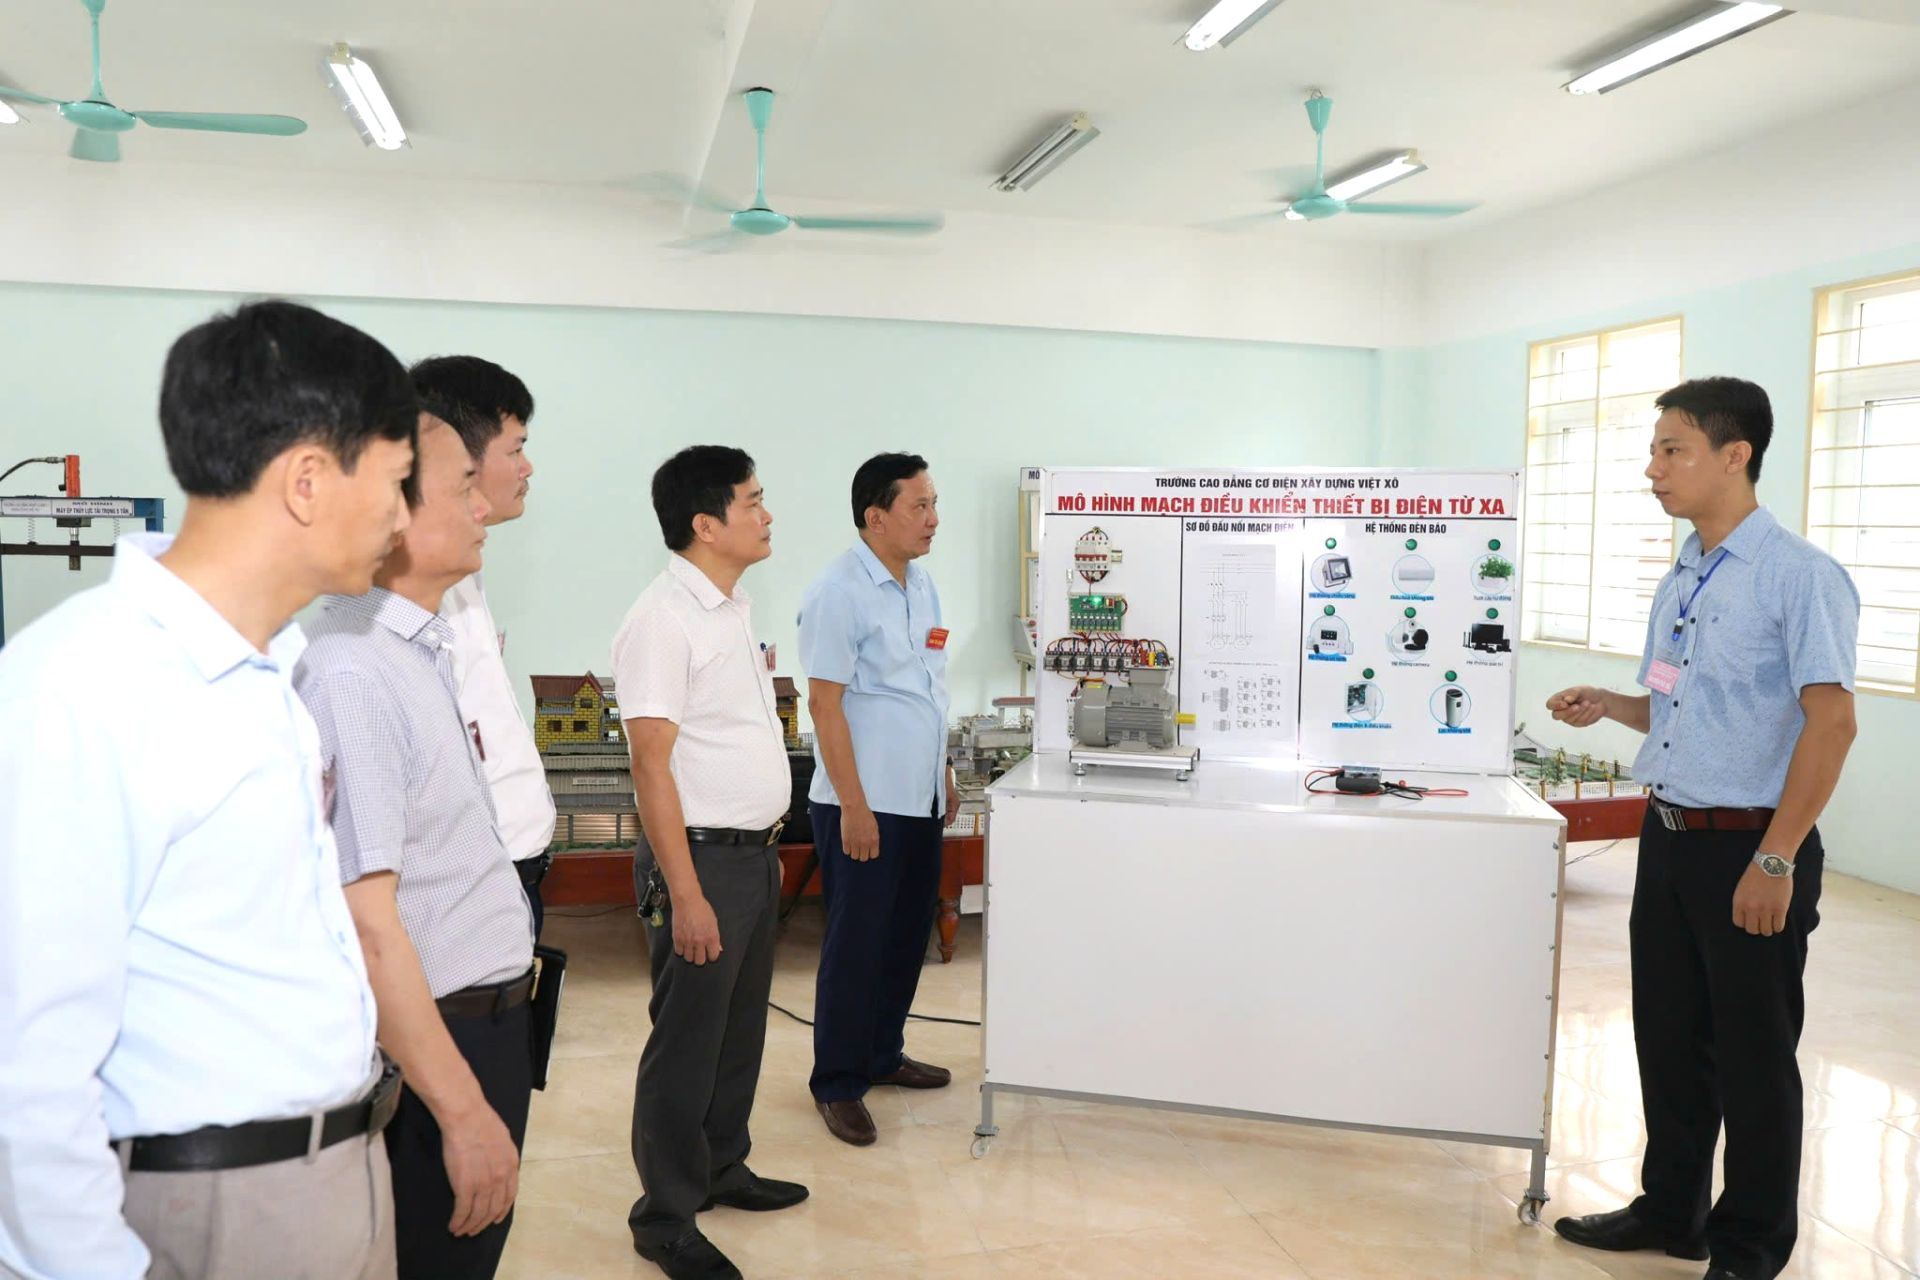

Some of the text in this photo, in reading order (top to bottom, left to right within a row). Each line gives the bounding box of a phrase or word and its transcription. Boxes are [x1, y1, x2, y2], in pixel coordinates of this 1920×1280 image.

[1155, 474, 1399, 490] TRƯỜNG CAO ĐẲNG CƠ ĐIỆN XÂY DỰNG VIỆT XÔ
[1057, 493, 1086, 511] MÔ
[1091, 493, 1135, 512] HÌNH
[1141, 496, 1195, 516] MẠCH
[1250, 491, 1306, 514] KHIỂN
[1313, 493, 1364, 515] THIẾT
[1371, 498, 1390, 518] BỊ
[1396, 495, 1442, 518] ĐIỆN
[1449, 495, 1475, 514] TỪ
[1479, 499, 1505, 514] XA
[1186, 522, 1197, 532] SƠ
[1212, 520, 1229, 532] ĐẤU
[1231, 520, 1245, 532] NỐI
[1248, 522, 1272, 534] MẠCH
[1365, 521, 1377, 535] HỆ
[1379, 520, 1407, 533] THỐNG
[1409, 521, 1427, 534] ĐÈN
